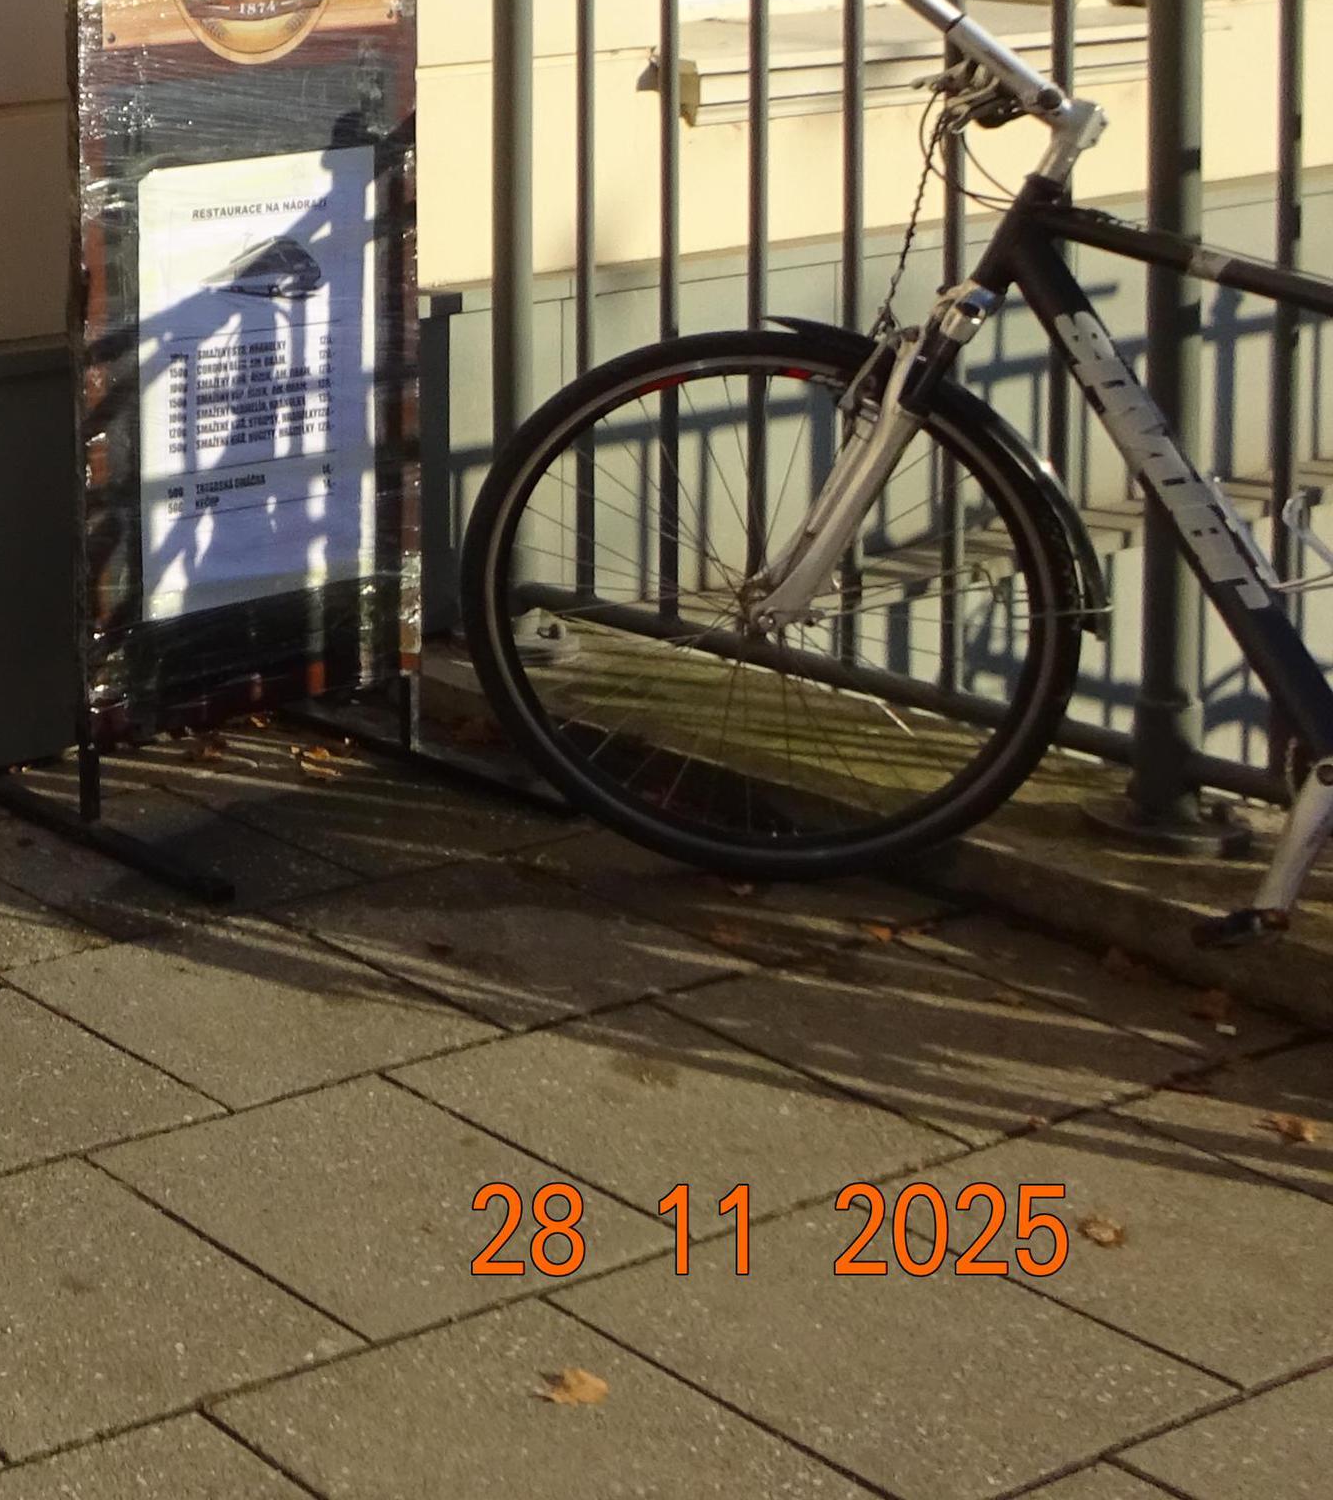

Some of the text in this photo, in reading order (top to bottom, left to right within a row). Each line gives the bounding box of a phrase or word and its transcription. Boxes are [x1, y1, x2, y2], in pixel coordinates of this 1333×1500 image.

[238, 0, 276, 15] 1874
[191, 203, 263, 220] RESTAURACE
[265, 201, 280, 213] NA
